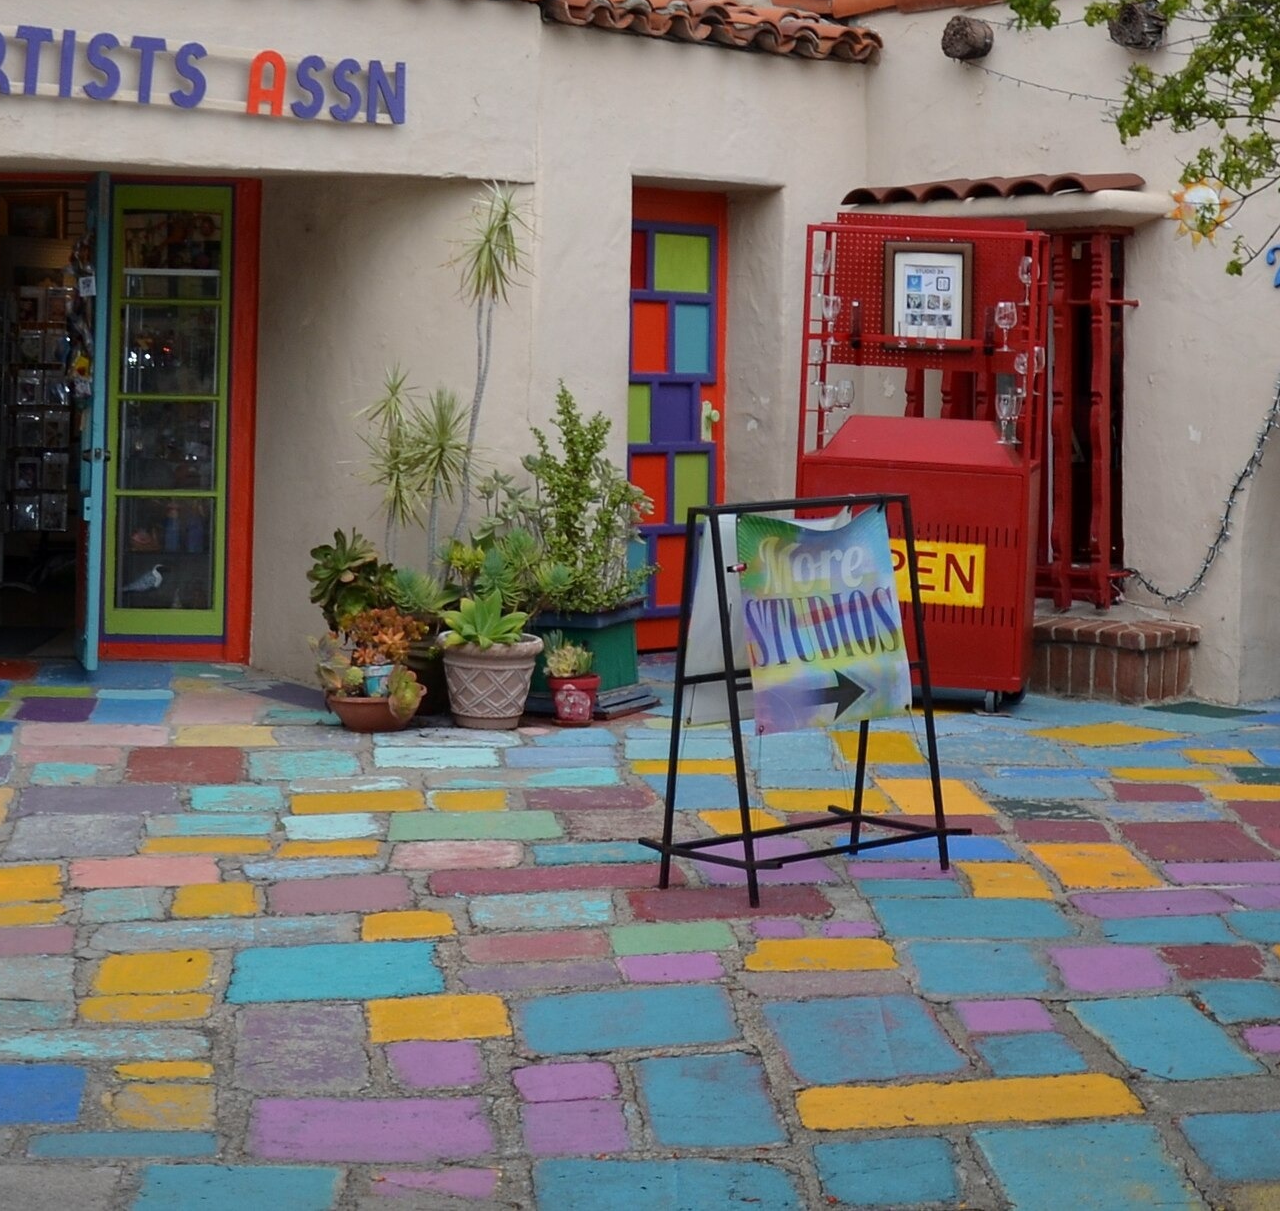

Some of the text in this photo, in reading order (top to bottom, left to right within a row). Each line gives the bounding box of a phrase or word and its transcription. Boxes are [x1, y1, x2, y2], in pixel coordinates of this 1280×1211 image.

[245, 49, 407, 126] ASSN
[758, 536, 866, 595] More
[744, 587, 901, 669] STUDIOS
